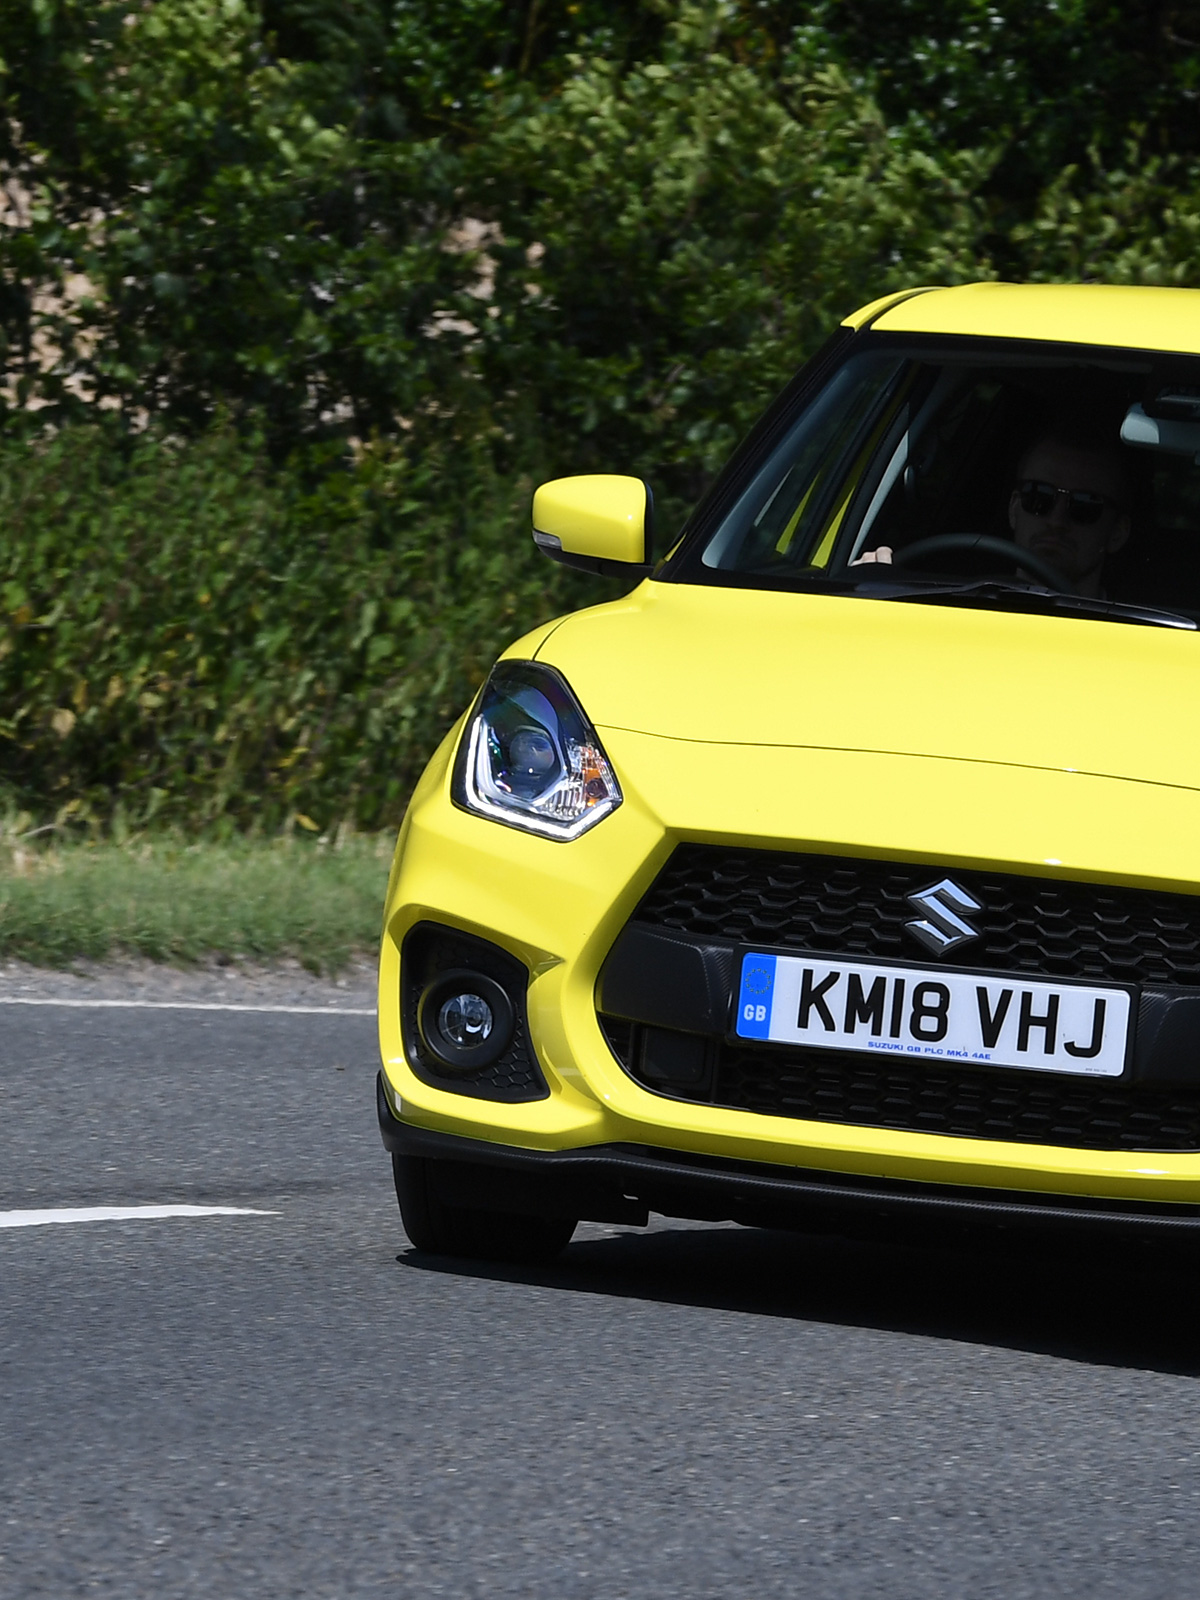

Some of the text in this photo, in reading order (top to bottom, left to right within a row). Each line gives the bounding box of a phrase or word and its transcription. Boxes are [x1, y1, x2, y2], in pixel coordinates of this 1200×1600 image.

[743, 1004, 767, 1022] GB
[797, 968, 1107, 1059] KM18 VHJ
[867, 1040, 991, 1060] SUZUKI GB PLC MK4 4AE
